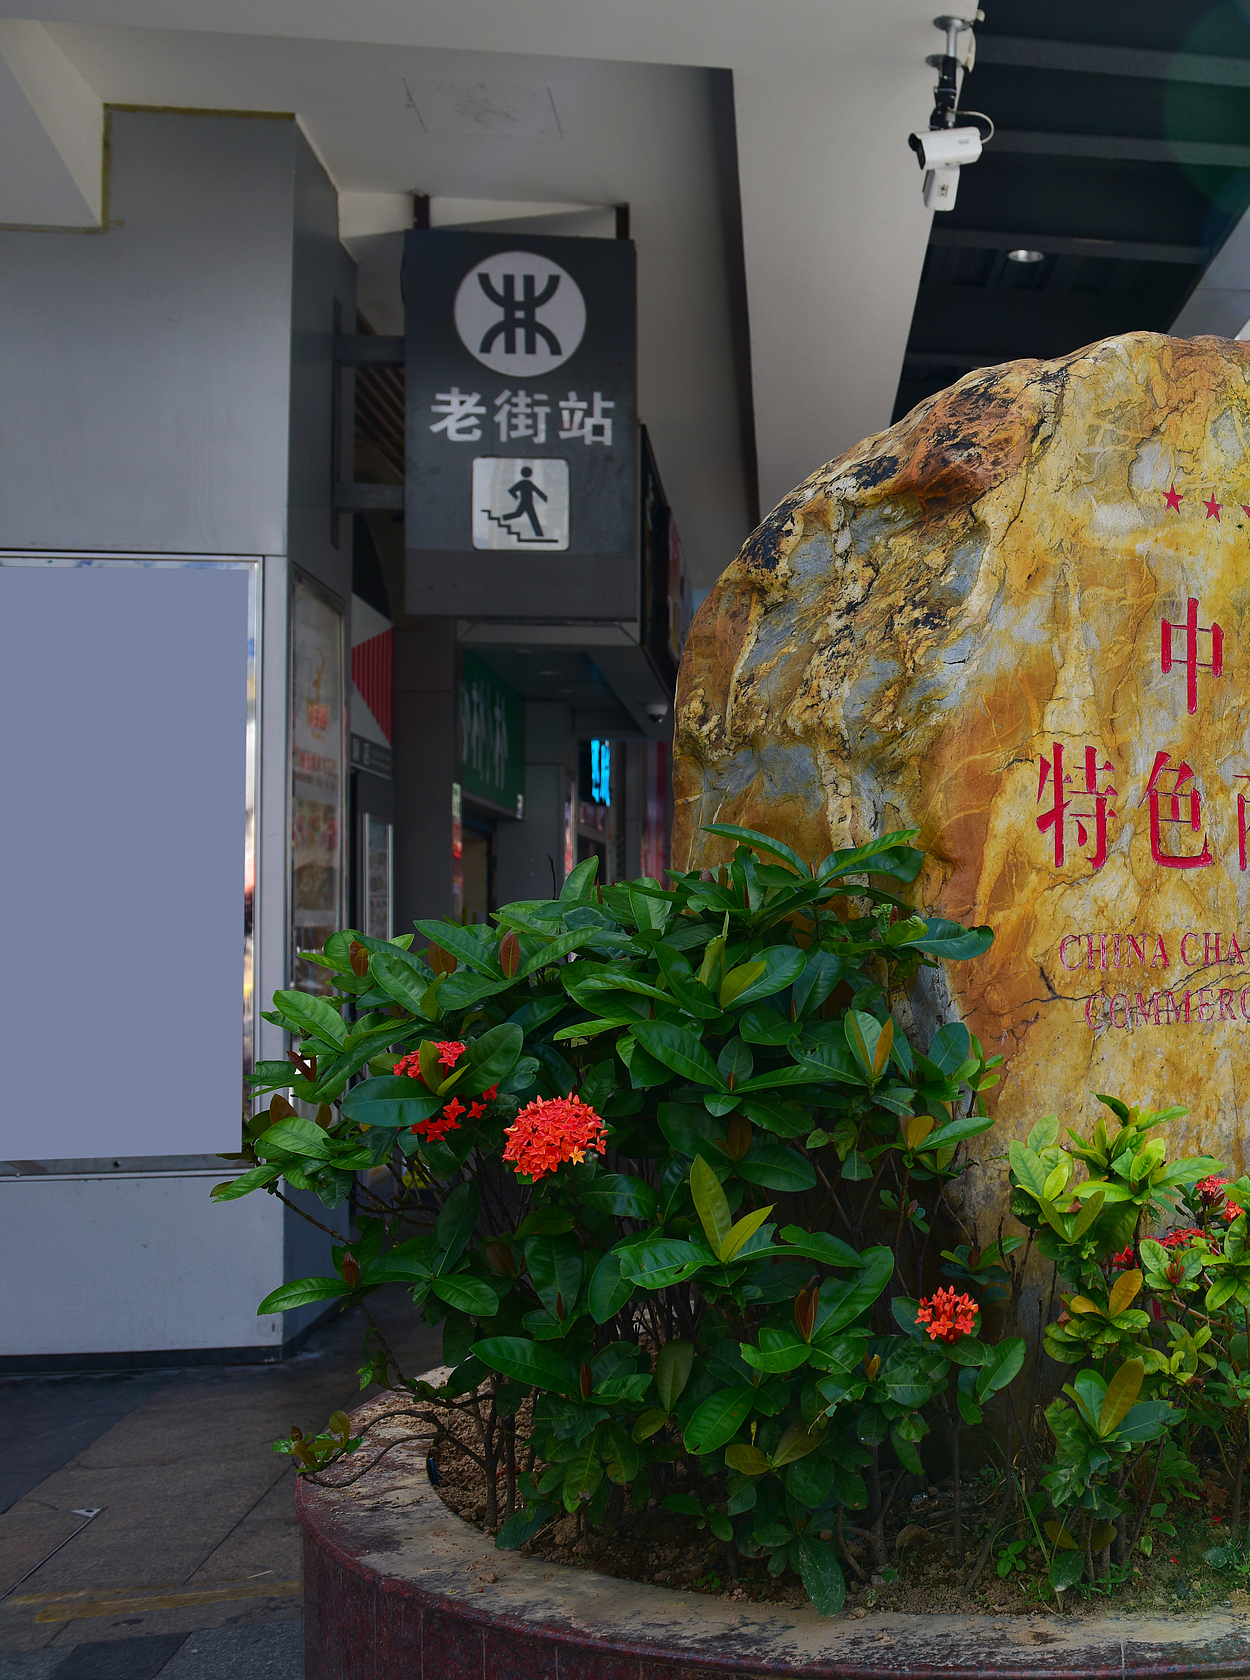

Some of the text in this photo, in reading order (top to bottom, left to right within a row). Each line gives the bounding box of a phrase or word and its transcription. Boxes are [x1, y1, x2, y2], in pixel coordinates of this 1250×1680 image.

[429, 386, 615, 446] 老街站
[1059, 932, 1171, 971] CHINA
